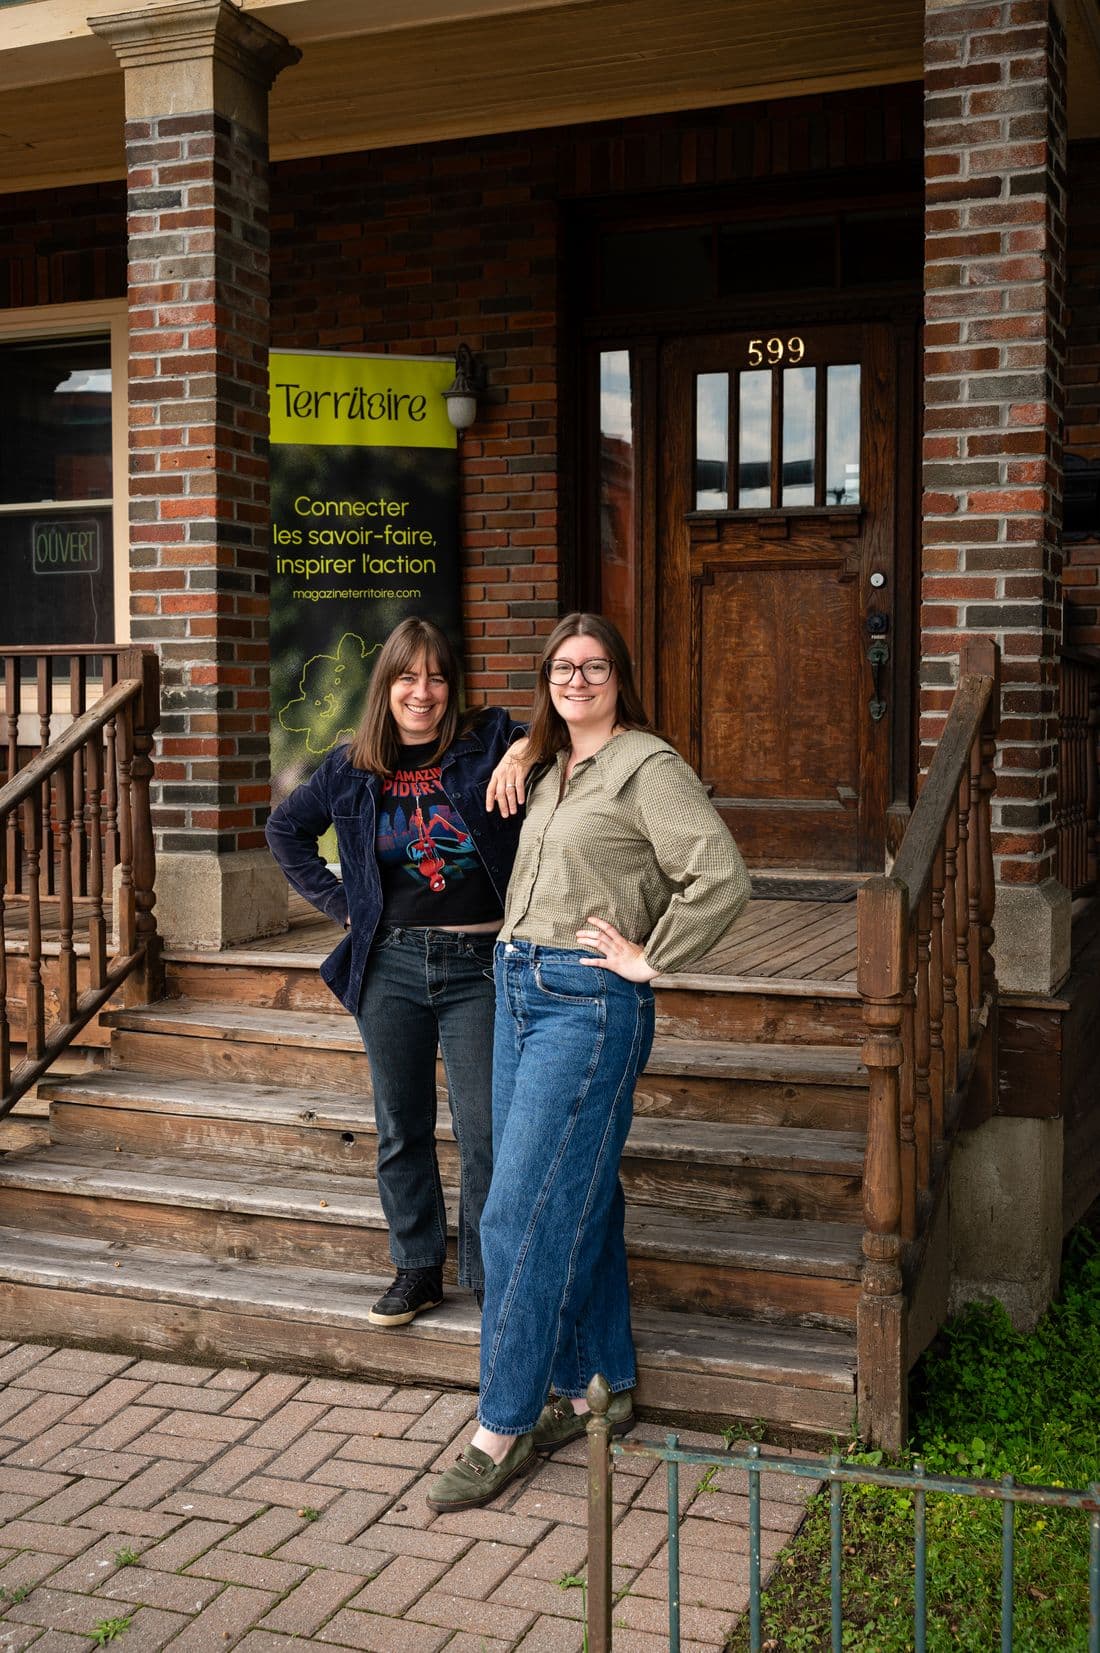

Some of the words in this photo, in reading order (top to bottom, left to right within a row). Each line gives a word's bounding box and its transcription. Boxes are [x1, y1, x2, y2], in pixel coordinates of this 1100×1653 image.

[748, 337, 805, 366] 599
[275, 383, 427, 422] Territoire
[294, 495, 409, 517] Connecter
[36, 531, 96, 563] OUVERT
[273, 523, 302, 545] les
[308, 524, 437, 547] savoir-faire,
[276, 554, 356, 580] inspirer
[362, 553, 437, 574] l'action
[293, 588, 421, 602] magazineterritoire.com
[381, 779, 444, 798] PIDER-
